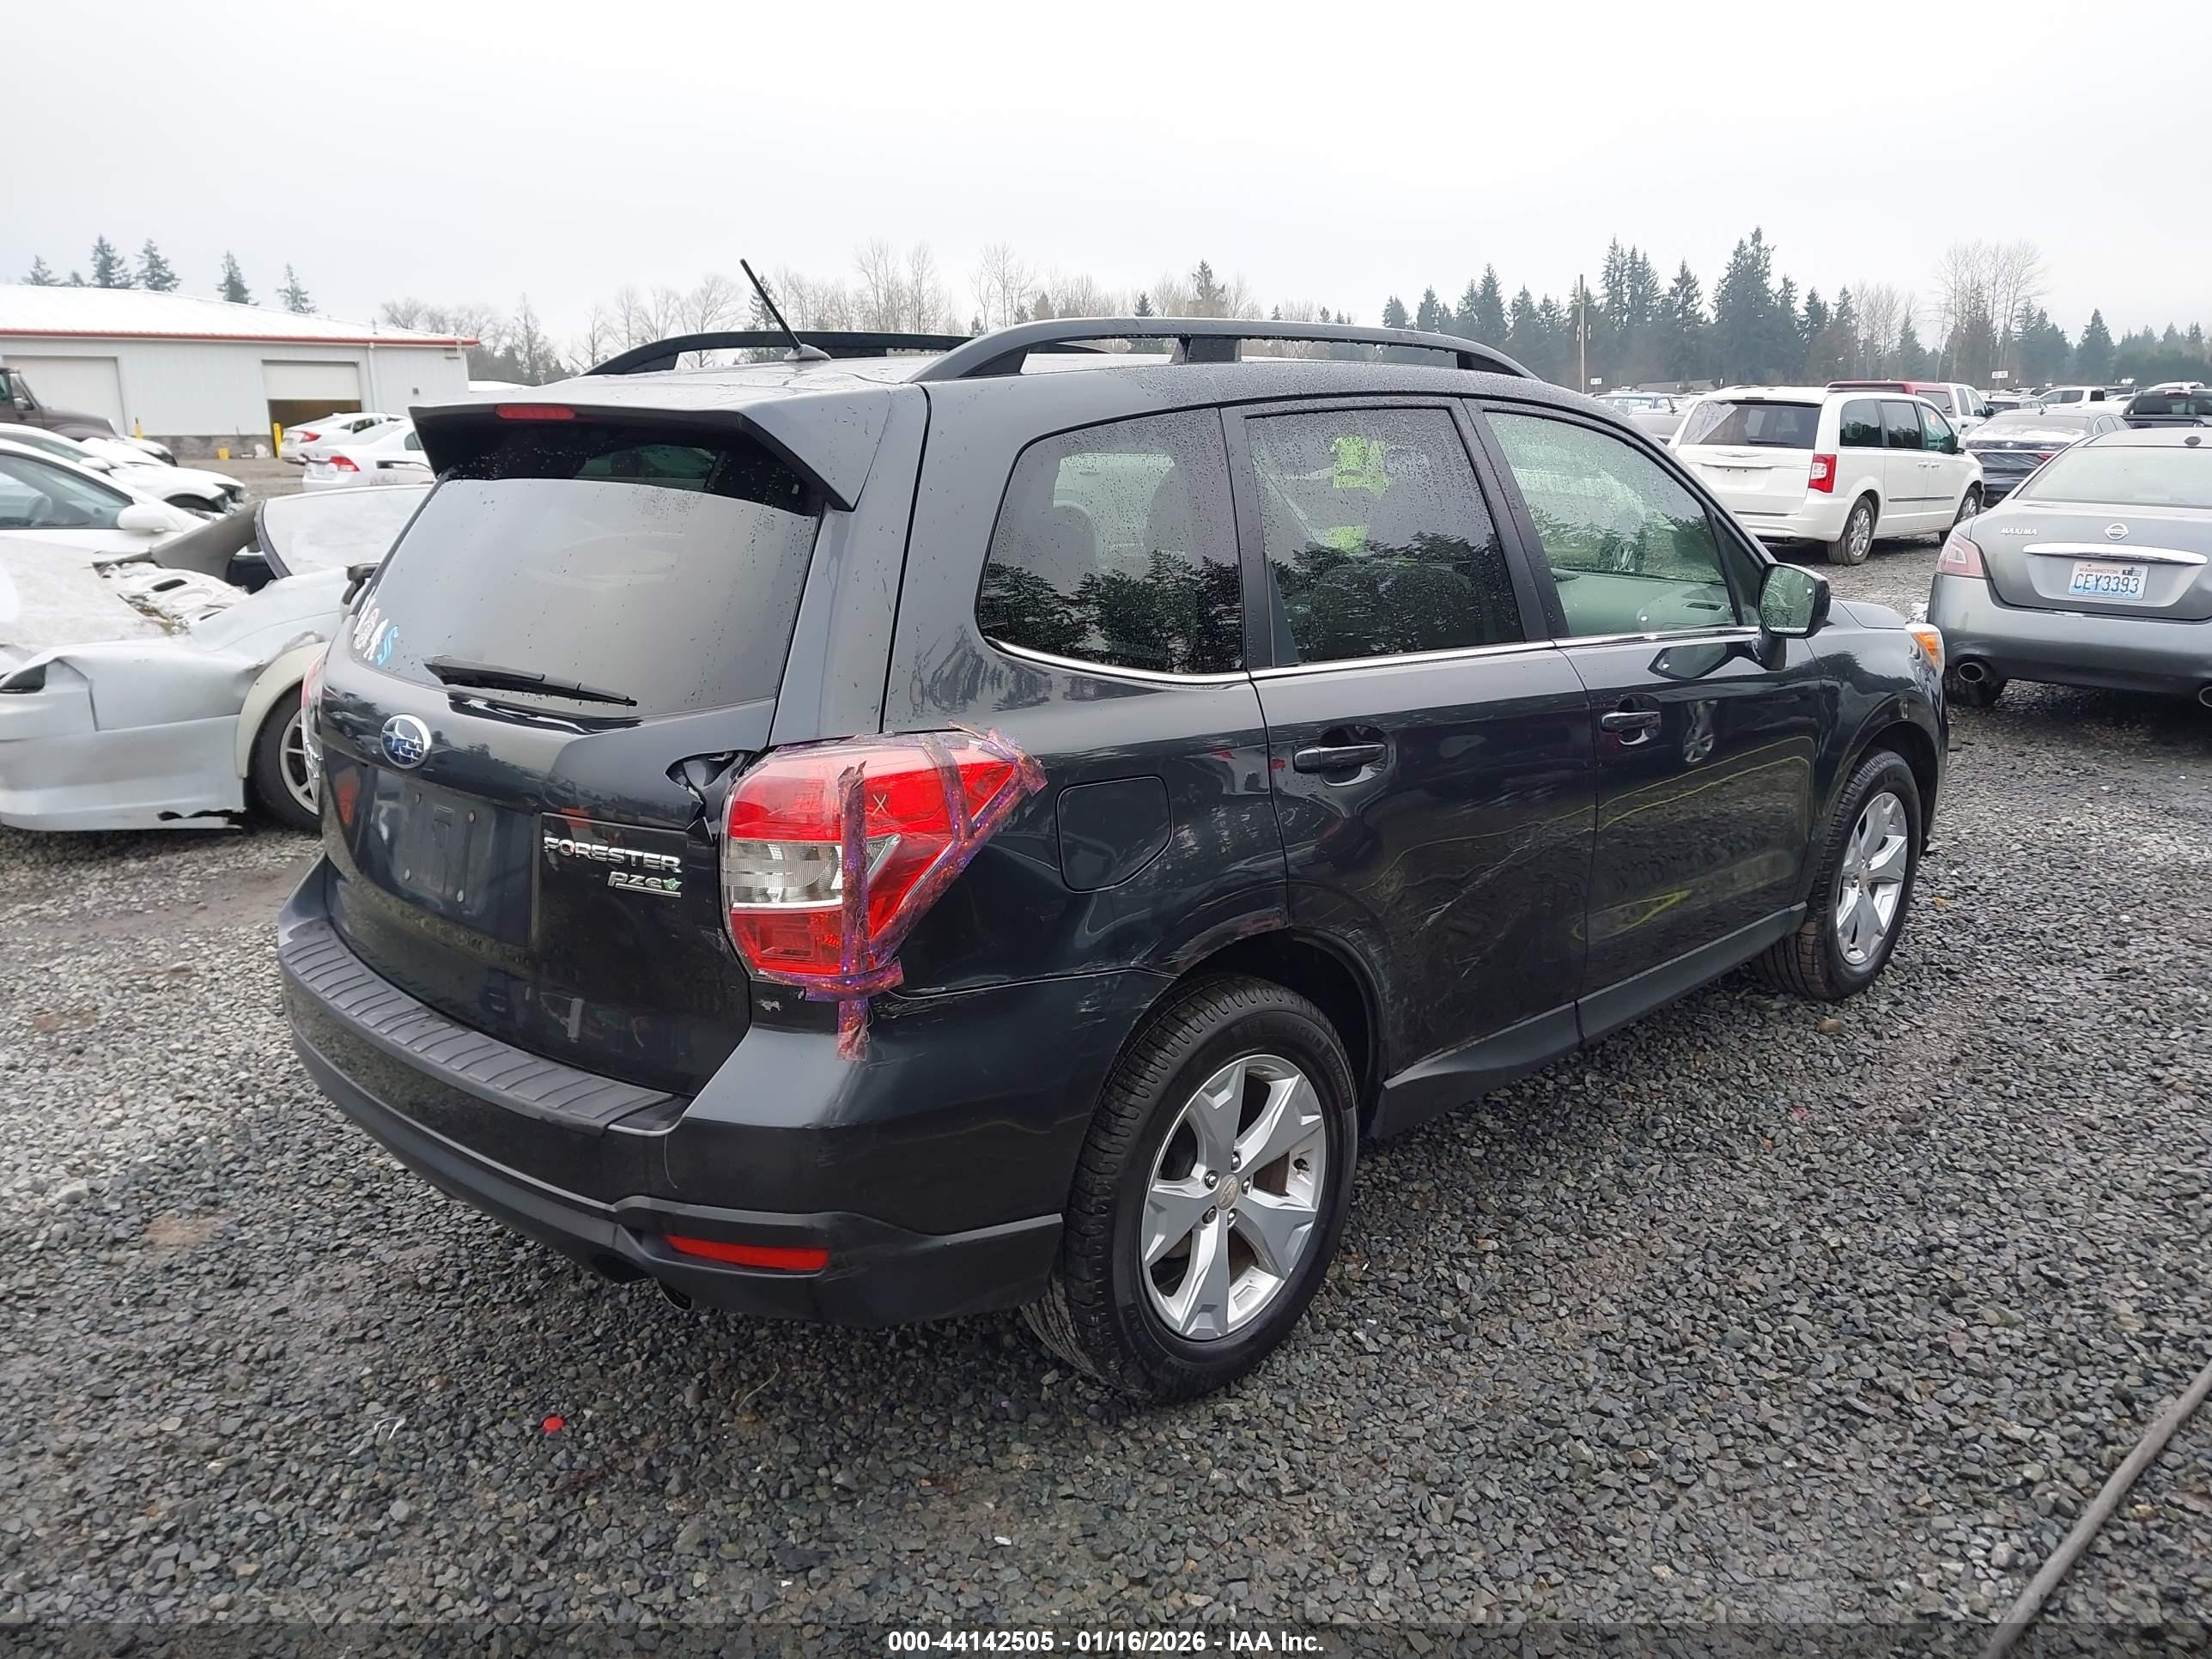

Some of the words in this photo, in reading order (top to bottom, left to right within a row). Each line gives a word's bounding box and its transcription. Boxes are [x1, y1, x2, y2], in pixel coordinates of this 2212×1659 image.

[1999, 526, 2038, 536] MAXIMA
[2074, 573, 2140, 593] CEY3393
[544, 836, 683, 873] FORESTER
